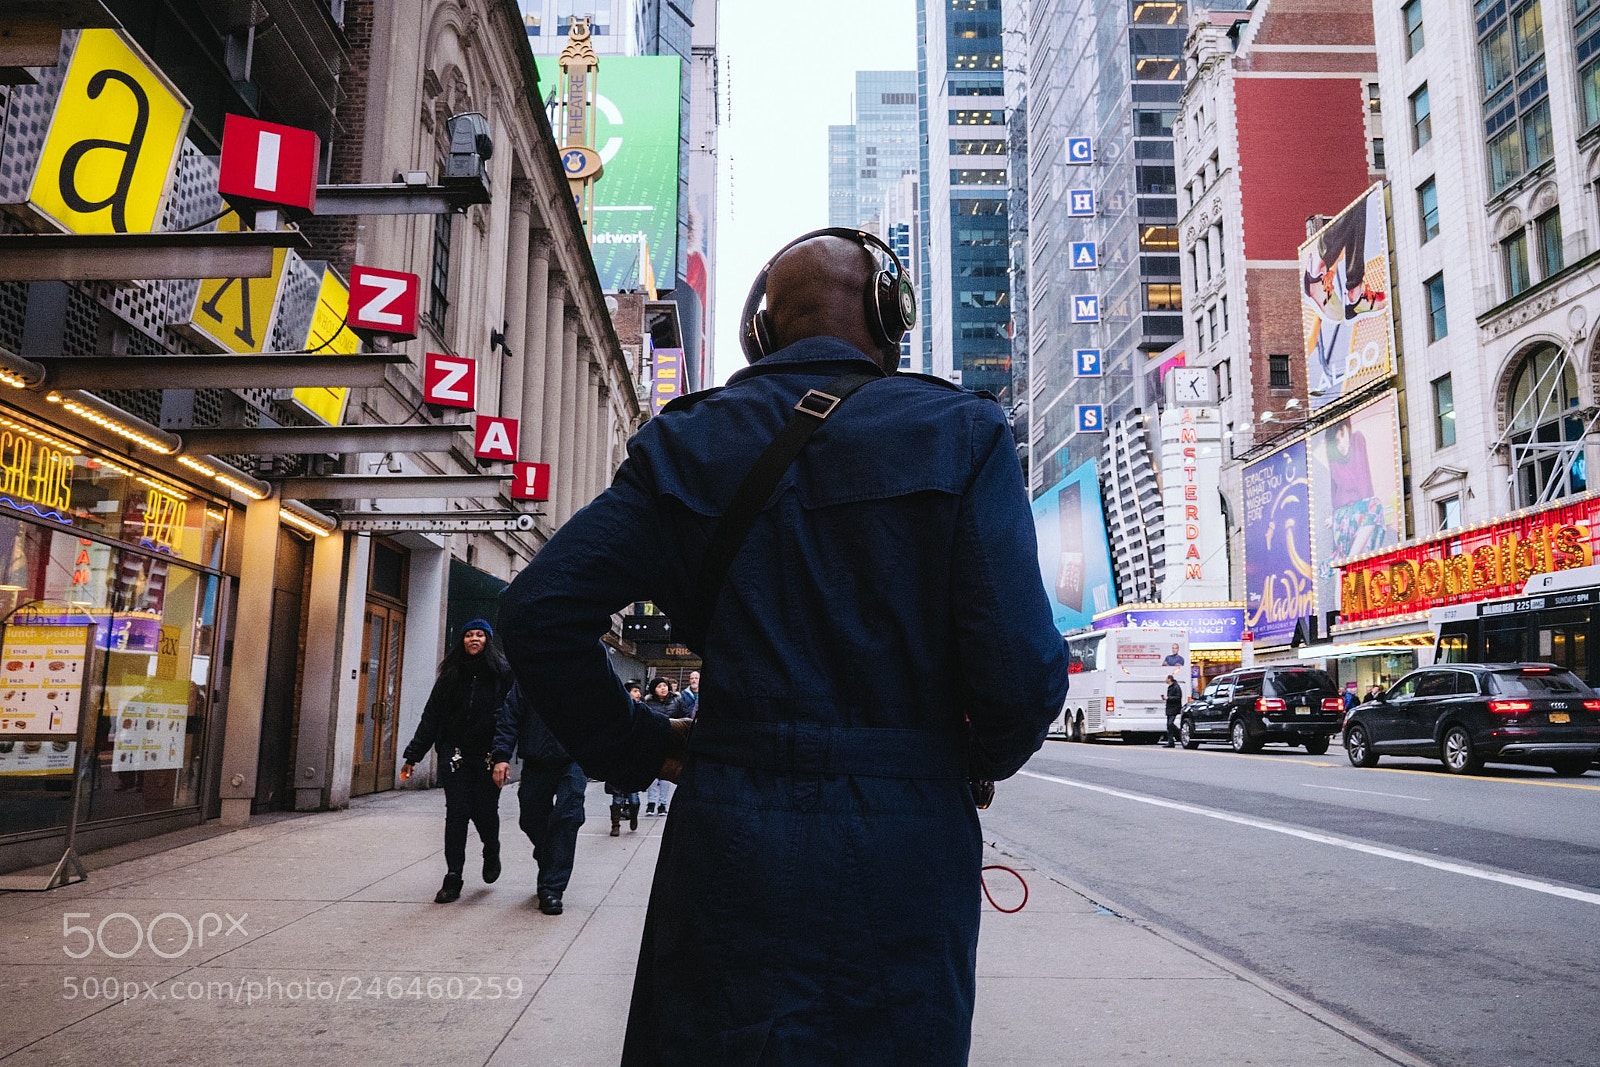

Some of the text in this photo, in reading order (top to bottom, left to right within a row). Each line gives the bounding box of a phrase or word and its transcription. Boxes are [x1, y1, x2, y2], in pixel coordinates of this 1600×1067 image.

[568, 74, 585, 136] THEATRE
[1072, 140, 1099, 428] CHAMPS
[1317, 340, 1380, 393] ALDO
[0, 431, 74, 512] SALADS
[1180, 408, 1202, 580] AMSTERDAM
[1266, 473, 1283, 489] YOU
[143, 489, 188, 550] PIZZA
[1246, 569, 1314, 628] Aladdin
[1339, 522, 1593, 616] McDonald's
[7, 628, 84, 640] lunch specials
[665, 647, 692, 656] LYRIC
[1140, 616, 1237, 628] ASK ABOUT TODAY'S
